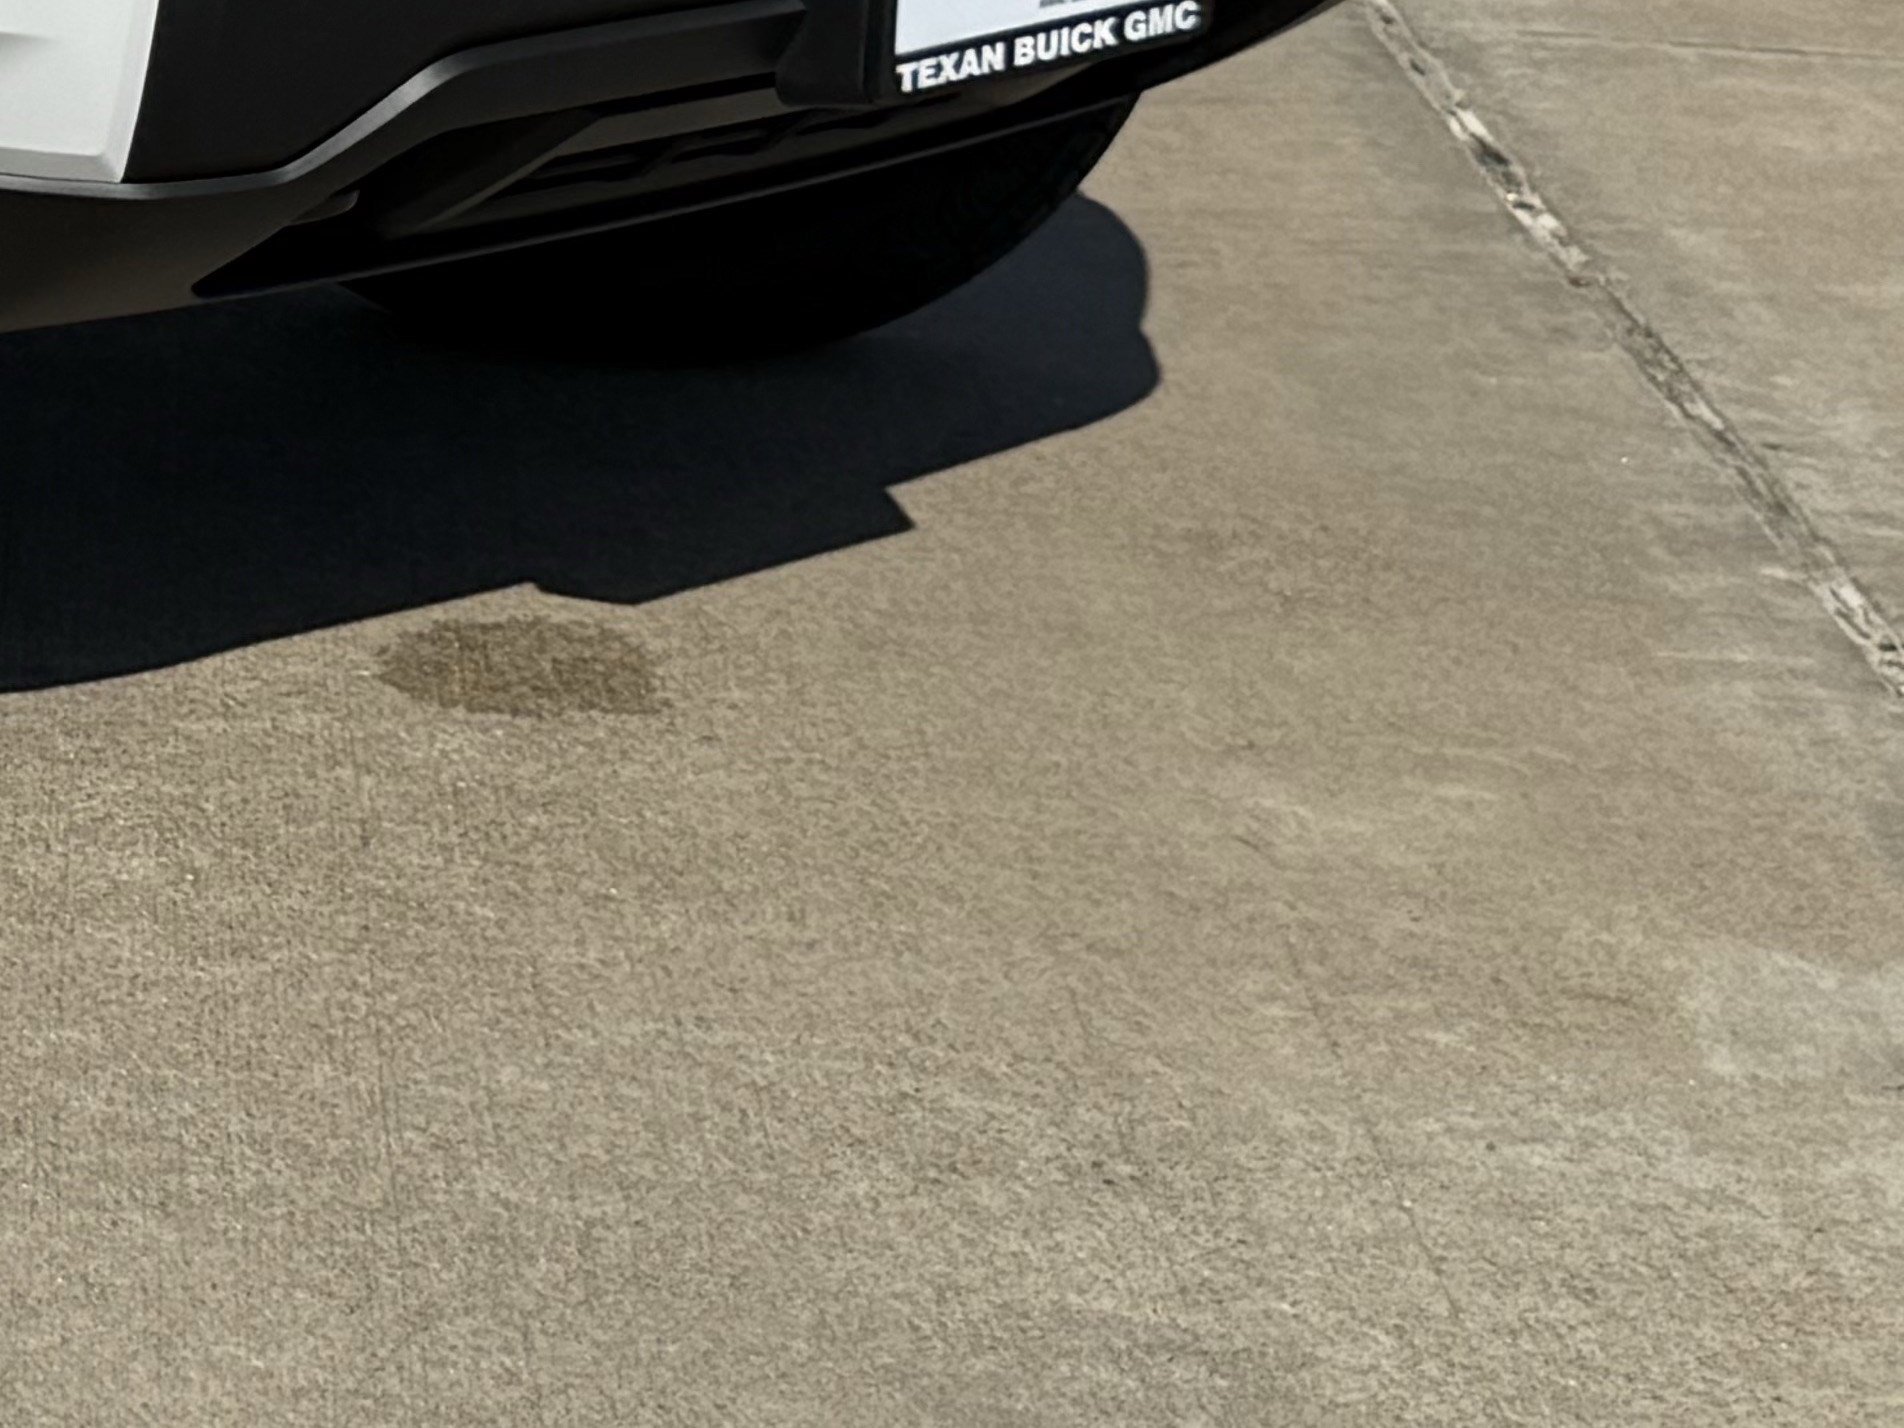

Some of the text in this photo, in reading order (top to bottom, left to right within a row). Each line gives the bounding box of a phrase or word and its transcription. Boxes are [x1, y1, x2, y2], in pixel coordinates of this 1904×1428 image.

[896, 0, 1201, 92] TEXAN BUICK GMC
